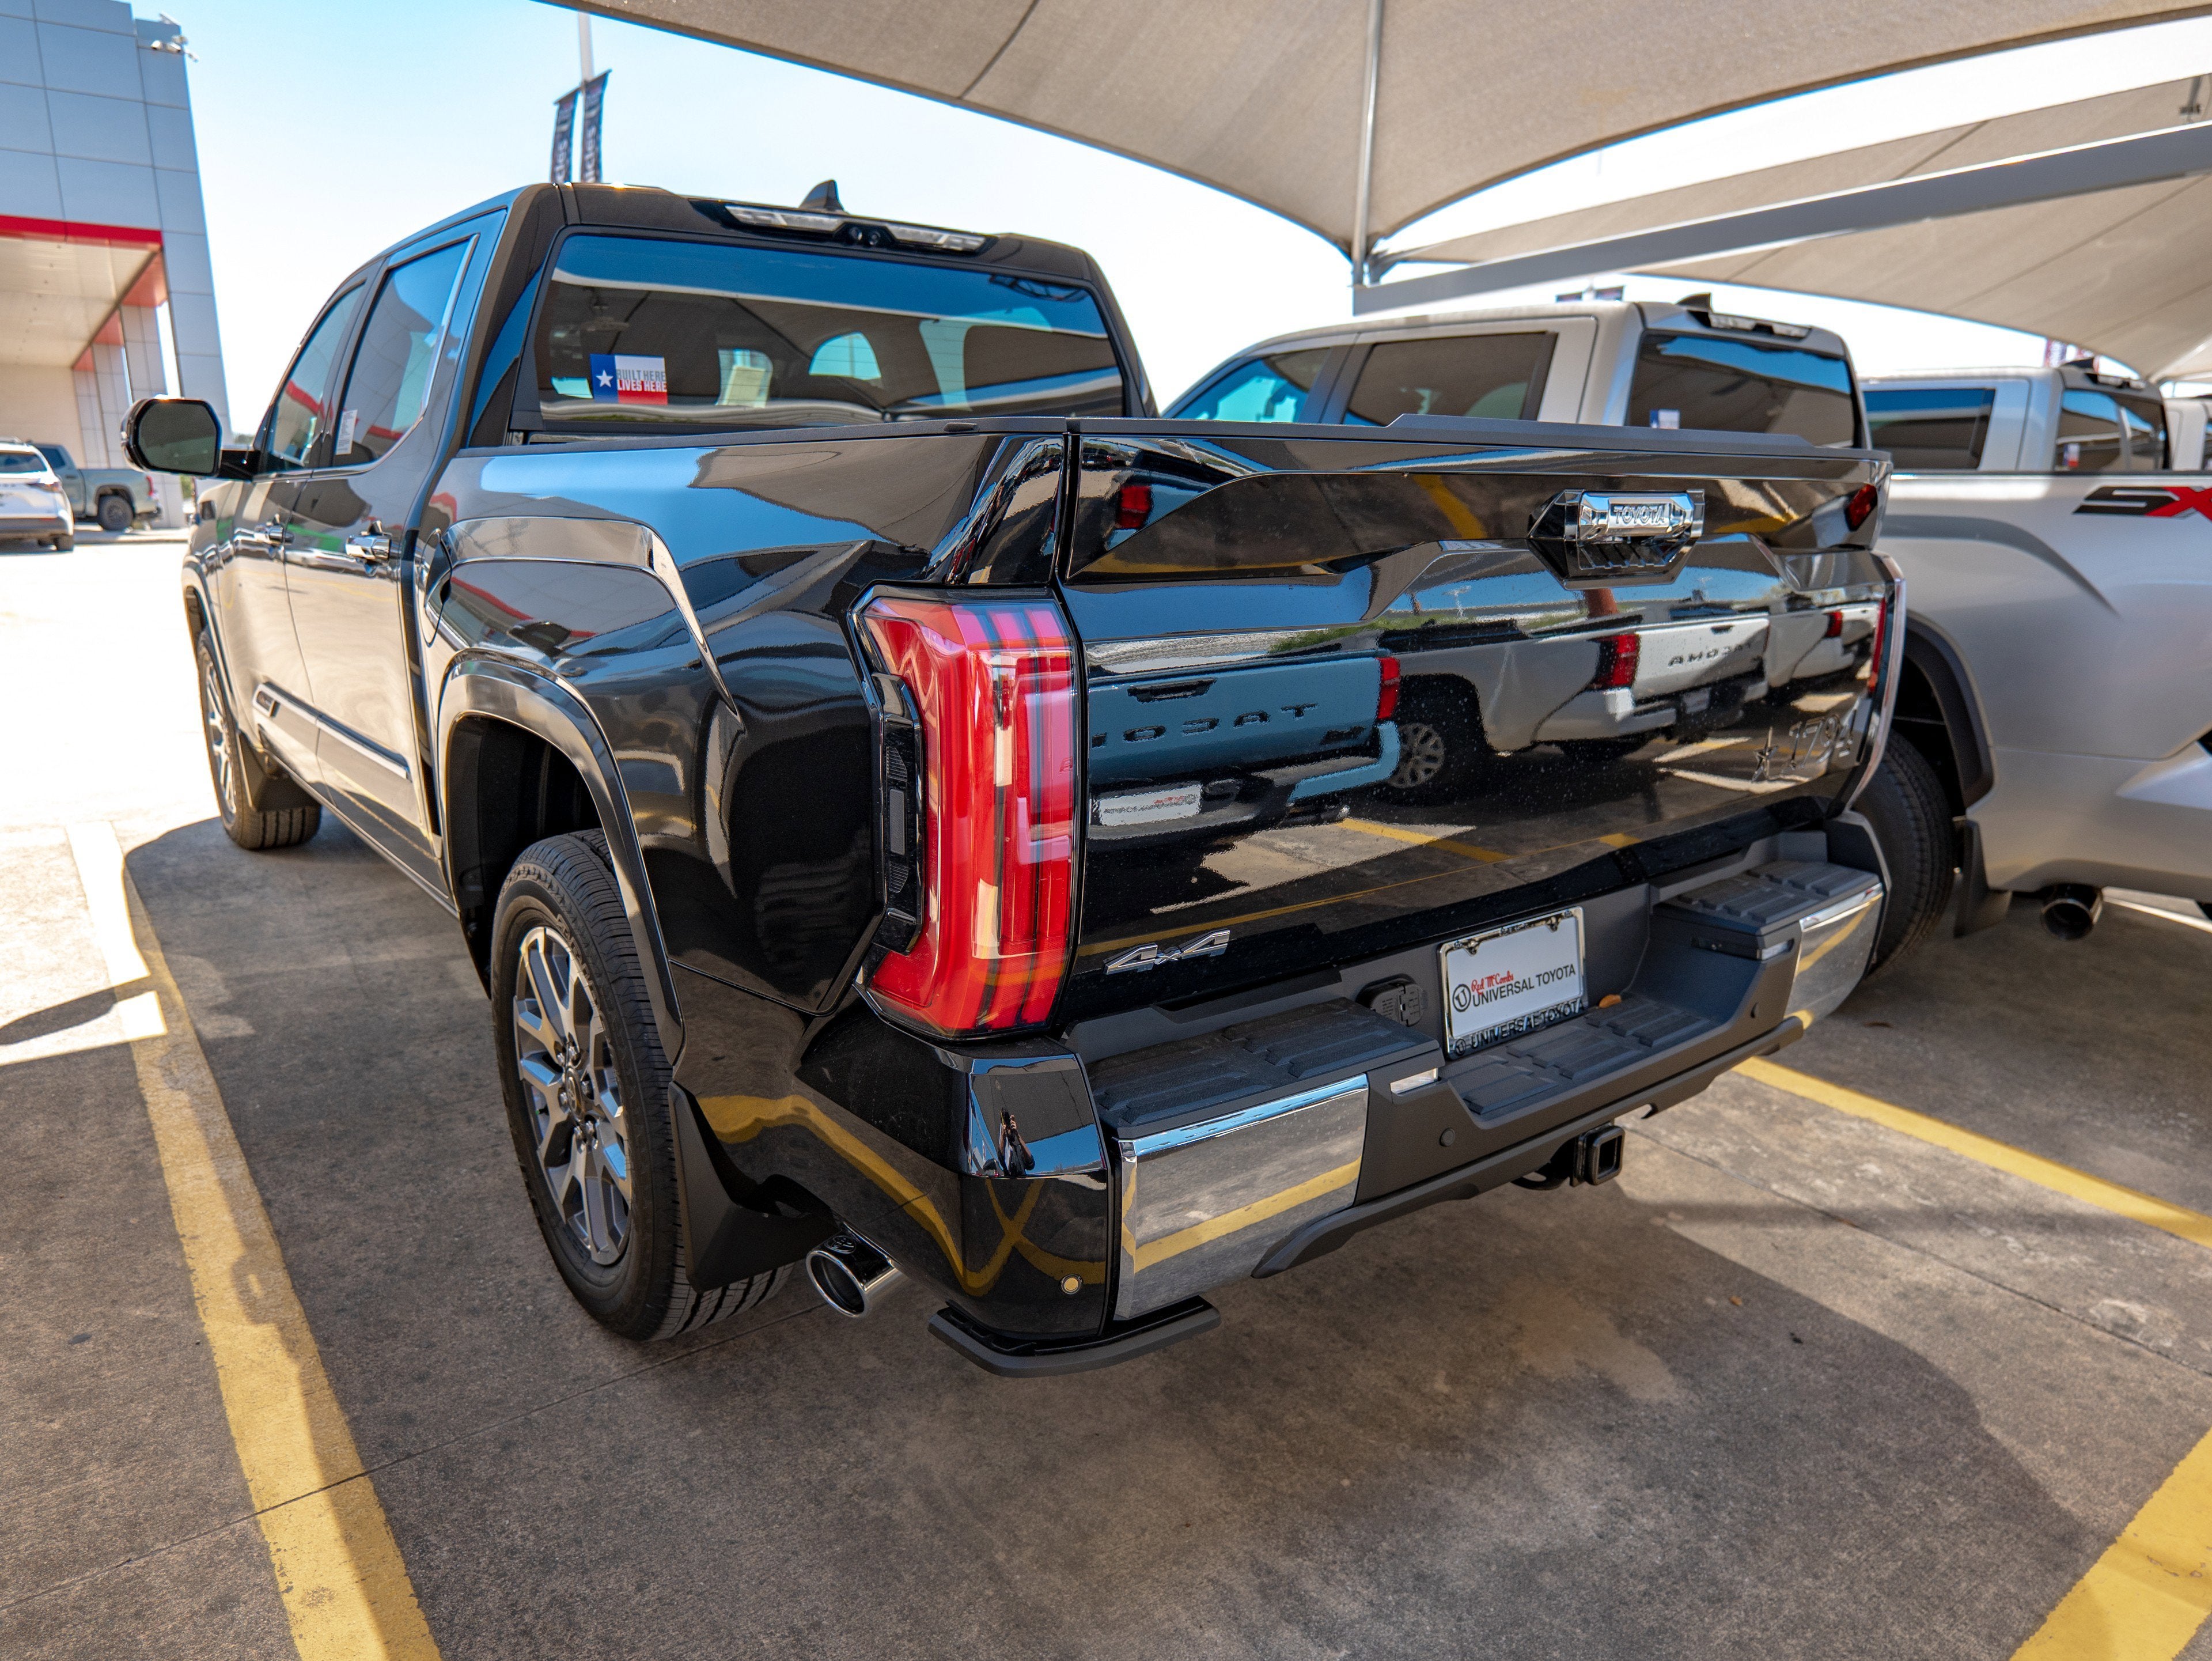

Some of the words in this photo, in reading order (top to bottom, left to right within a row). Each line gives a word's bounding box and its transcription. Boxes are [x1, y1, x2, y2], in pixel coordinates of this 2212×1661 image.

[616, 369, 642, 381] BUILT
[643, 369, 666, 381] HERE
[618, 379, 643, 391] LIVES
[644, 380, 667, 392] HERE
[1613, 504, 1665, 525] TOYOTA
[1471, 979, 1484, 994] Red
[1472, 977, 1535, 1007] UNIVERSAL
[1536, 964, 1575, 986] TOYOTA
[1471, 1016, 1540, 1049] UNIVERSAL
[1540, 998, 1585, 1024] TOYOTA
